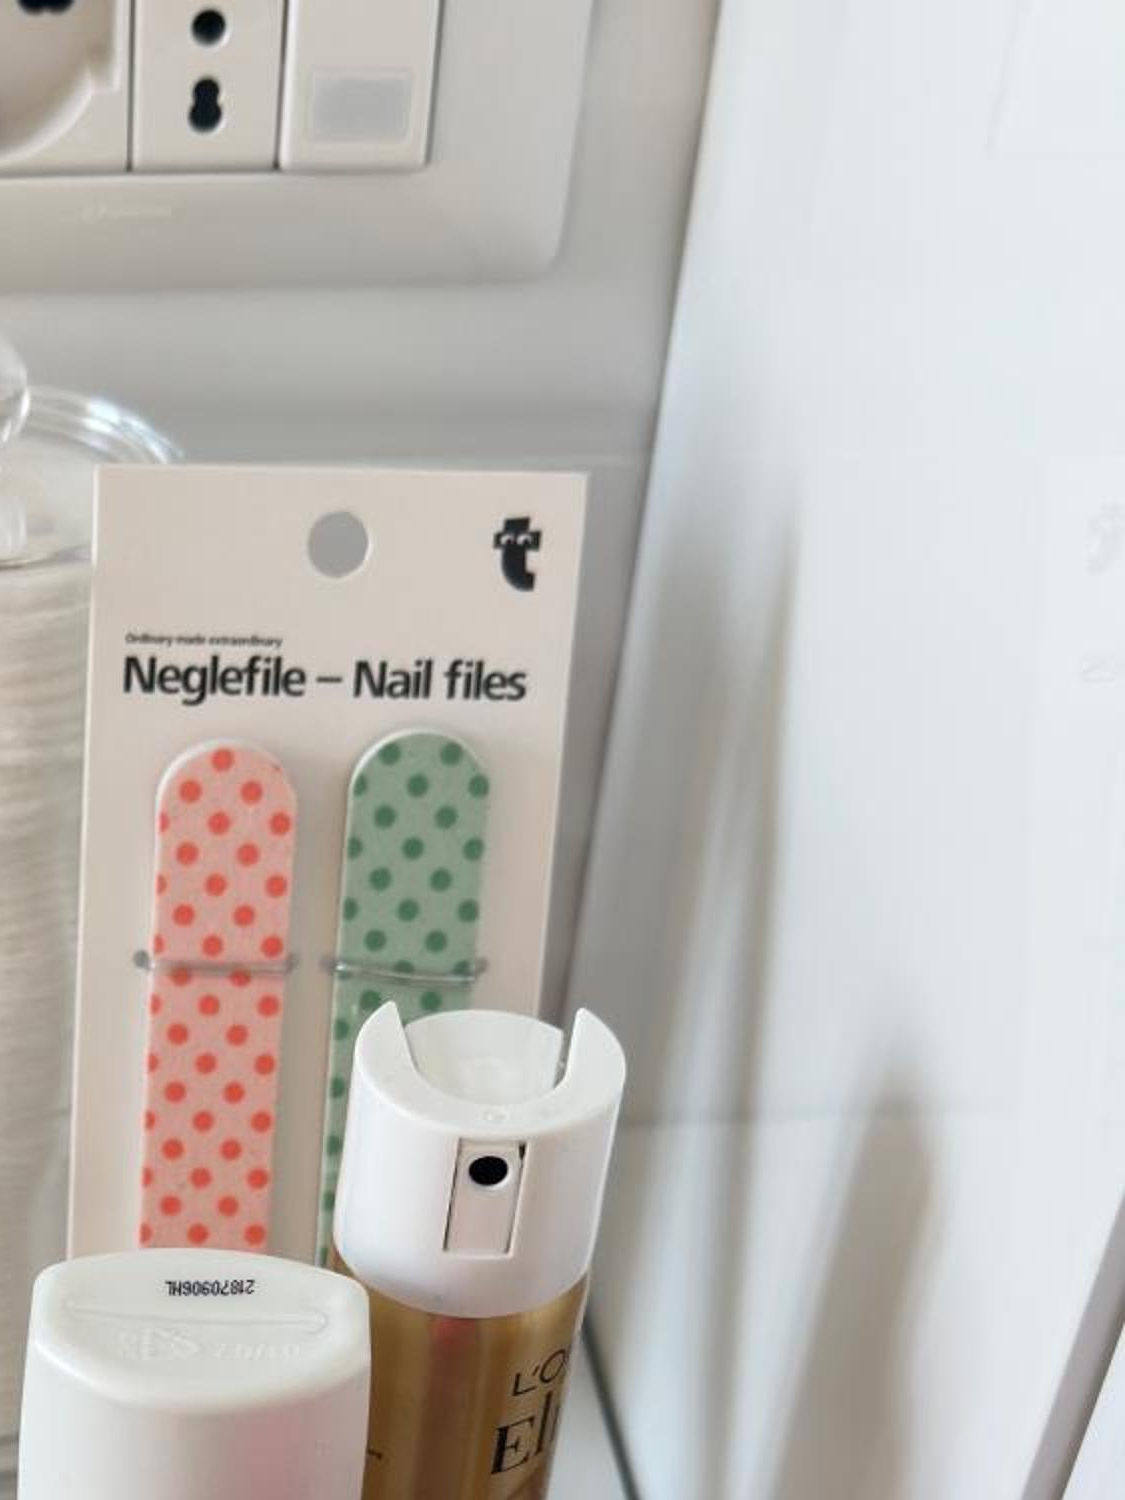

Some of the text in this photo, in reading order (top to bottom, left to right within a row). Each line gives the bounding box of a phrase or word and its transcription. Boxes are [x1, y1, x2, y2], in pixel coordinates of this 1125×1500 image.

[124, 655, 306, 706] Neglefile
[352, 659, 434, 700] Nail
[443, 660, 527, 702] files
